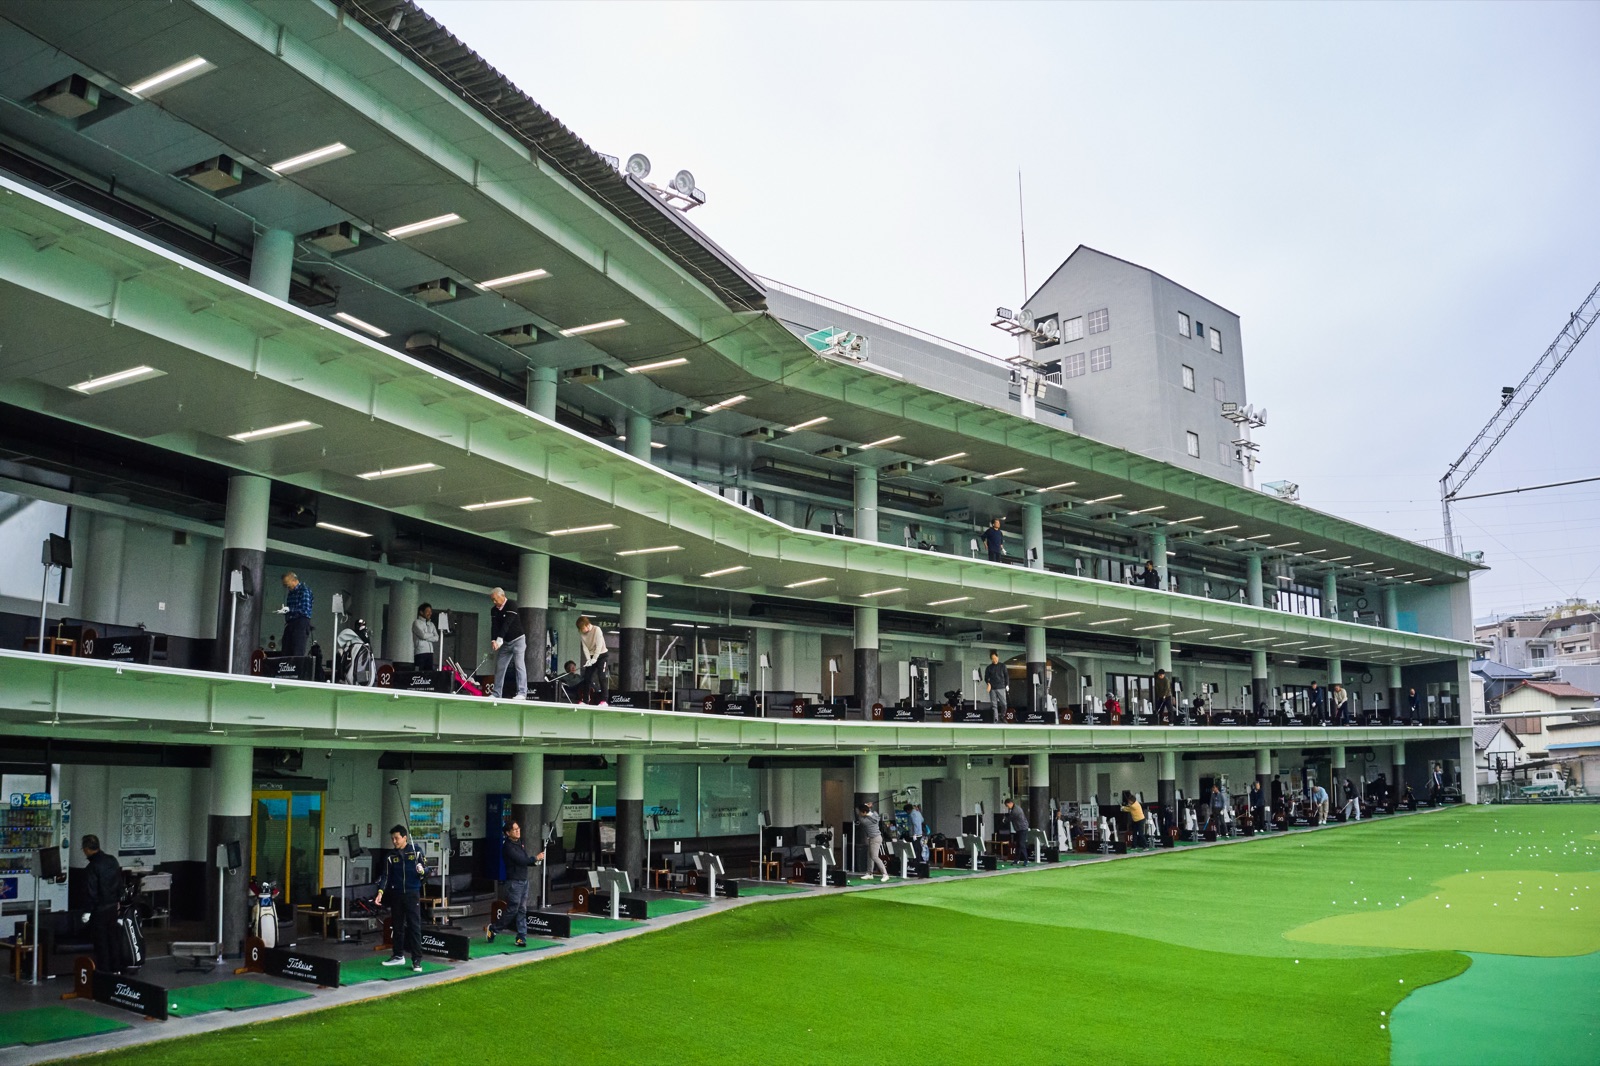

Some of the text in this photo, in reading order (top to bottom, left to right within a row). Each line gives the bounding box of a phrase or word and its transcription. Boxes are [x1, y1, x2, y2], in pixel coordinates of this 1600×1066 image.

[84, 640, 94, 655] 30
[253, 659, 261, 672] 31
[380, 673, 391, 685] 32
[704, 701, 713, 710] 35
[794, 705, 803, 714] 36
[874, 708, 882, 716] 37
[947, 854, 954, 862] 13
[690, 876, 697, 886] 10
[578, 894, 584, 905] 9
[527, 916, 548, 926] Titleist
[421, 935, 445, 947] Titleist
[252, 947, 258, 961] 6
[286, 957, 313, 971] Titleist
[81, 968, 88, 984] 5
[114, 983, 141, 1000] Titleist
